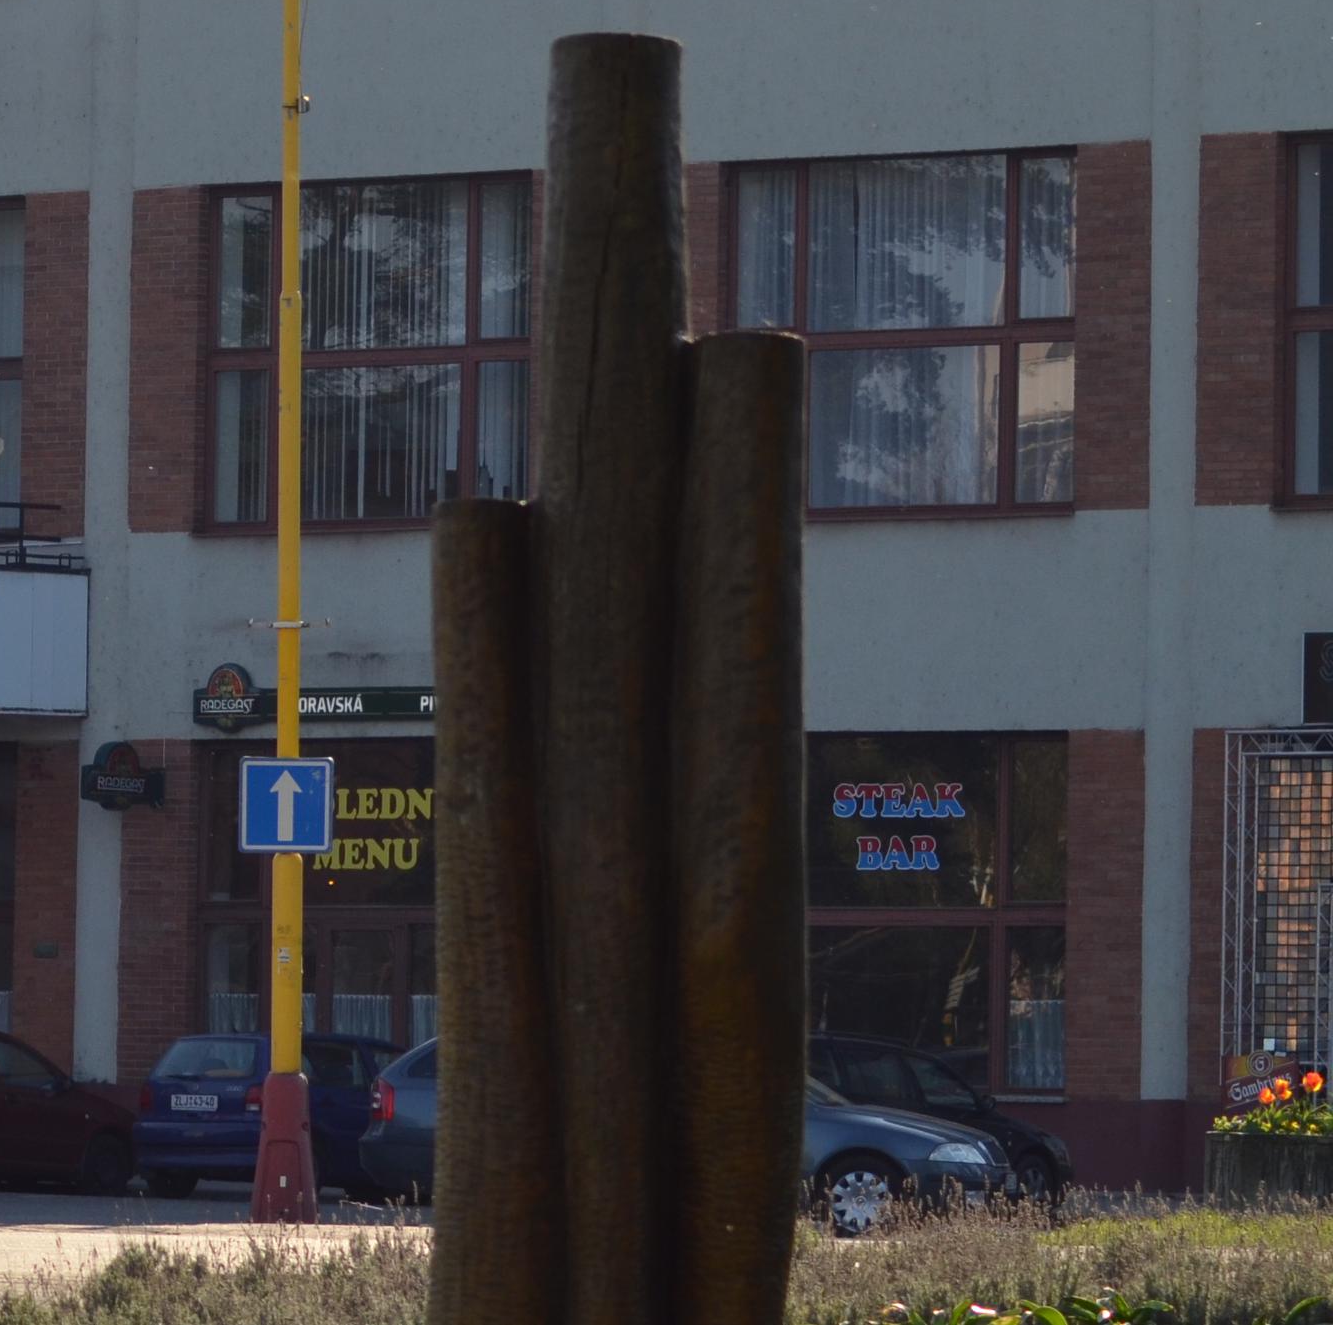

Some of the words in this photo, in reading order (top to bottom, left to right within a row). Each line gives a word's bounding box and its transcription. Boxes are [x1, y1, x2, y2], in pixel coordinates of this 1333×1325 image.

[200, 698, 255, 714] RADEGAST
[298, 693, 363, 713] ORAVSKÁ
[97, 775, 145, 793] RADEGAST
[833, 782, 965, 818] STEAK
[331, 787, 437, 820] LEDN
[313, 838, 419, 870] MENU
[856, 835, 940, 870] BAR
